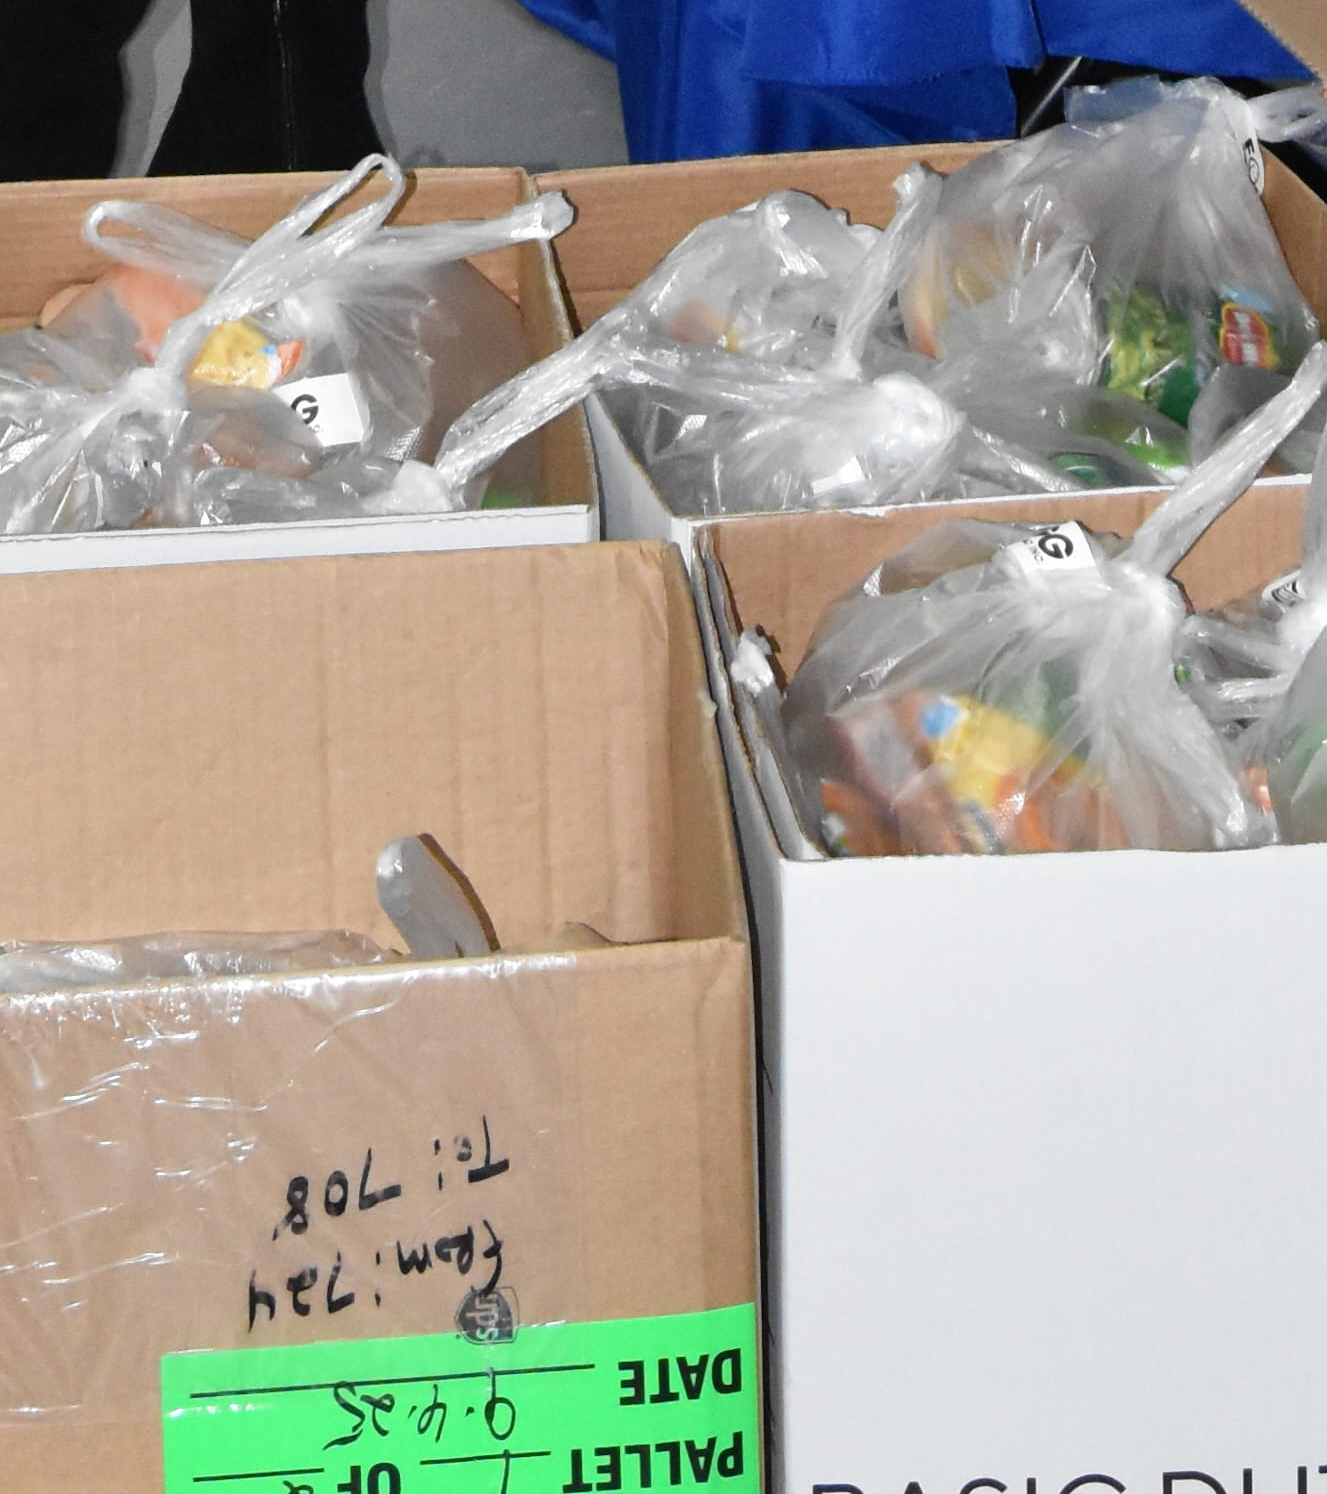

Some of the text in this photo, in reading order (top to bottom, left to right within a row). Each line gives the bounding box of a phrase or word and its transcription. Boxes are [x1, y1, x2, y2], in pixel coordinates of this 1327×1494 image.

[272, 1147, 402, 1242] 708
[247, 1251, 356, 1335] 724
[617, 1348, 743, 1406] DATE
[562, 1430, 745, 1493] PALLET
